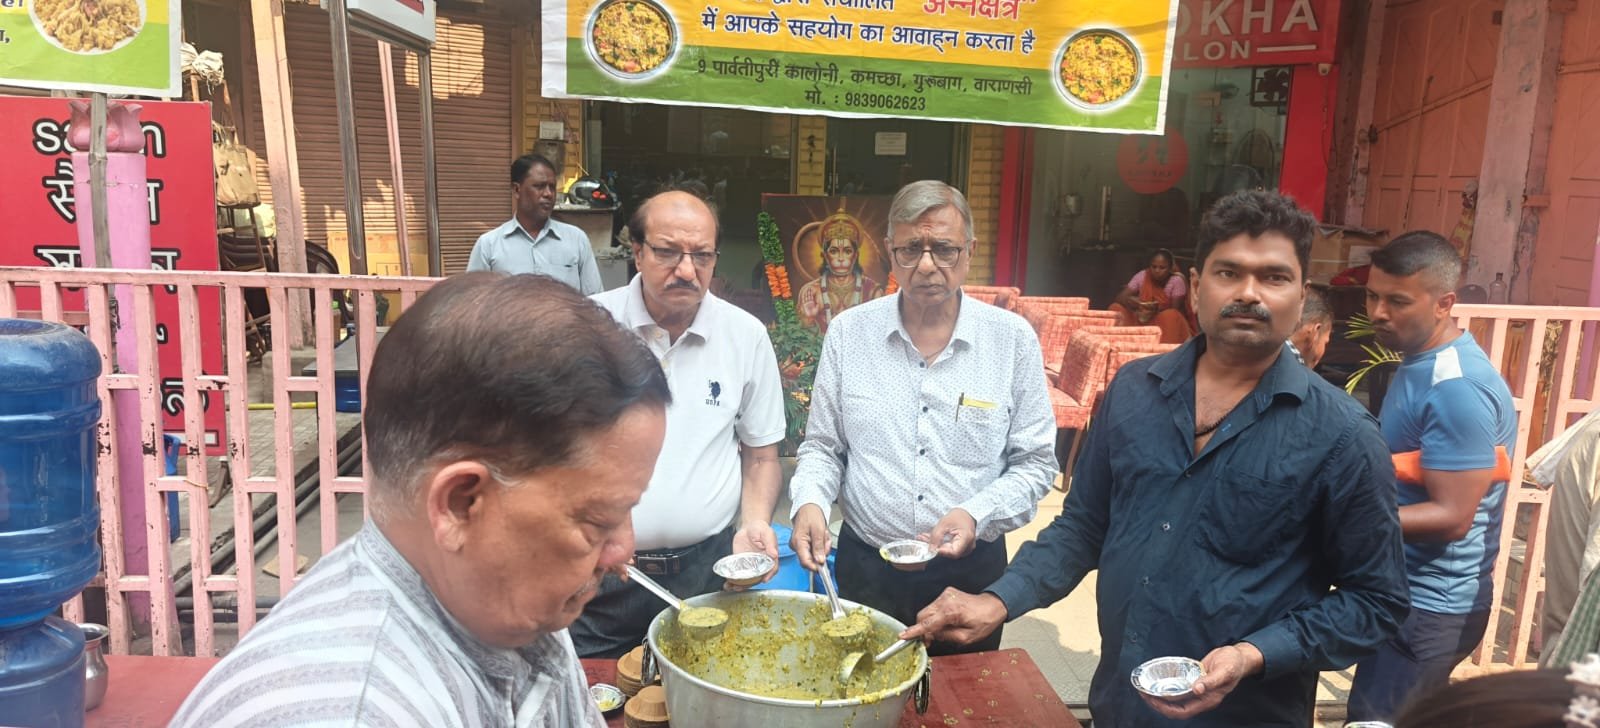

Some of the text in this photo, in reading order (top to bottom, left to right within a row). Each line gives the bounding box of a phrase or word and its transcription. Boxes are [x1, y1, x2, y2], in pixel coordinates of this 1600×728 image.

[701, 7, 718, 30] में
[725, 11, 780, 34] आपके
[787, 15, 853, 40] सहयोग
[860, 24, 884, 42] का
[966, 31, 1015, 51] करता
[1021, 29, 1036, 53] है
[1173, 40, 1249, 61] LON
[698, 59, 706, 73] 9
[974, 76, 1032, 95] वाराणसी
[845, 92, 926, 111] 9839062623
